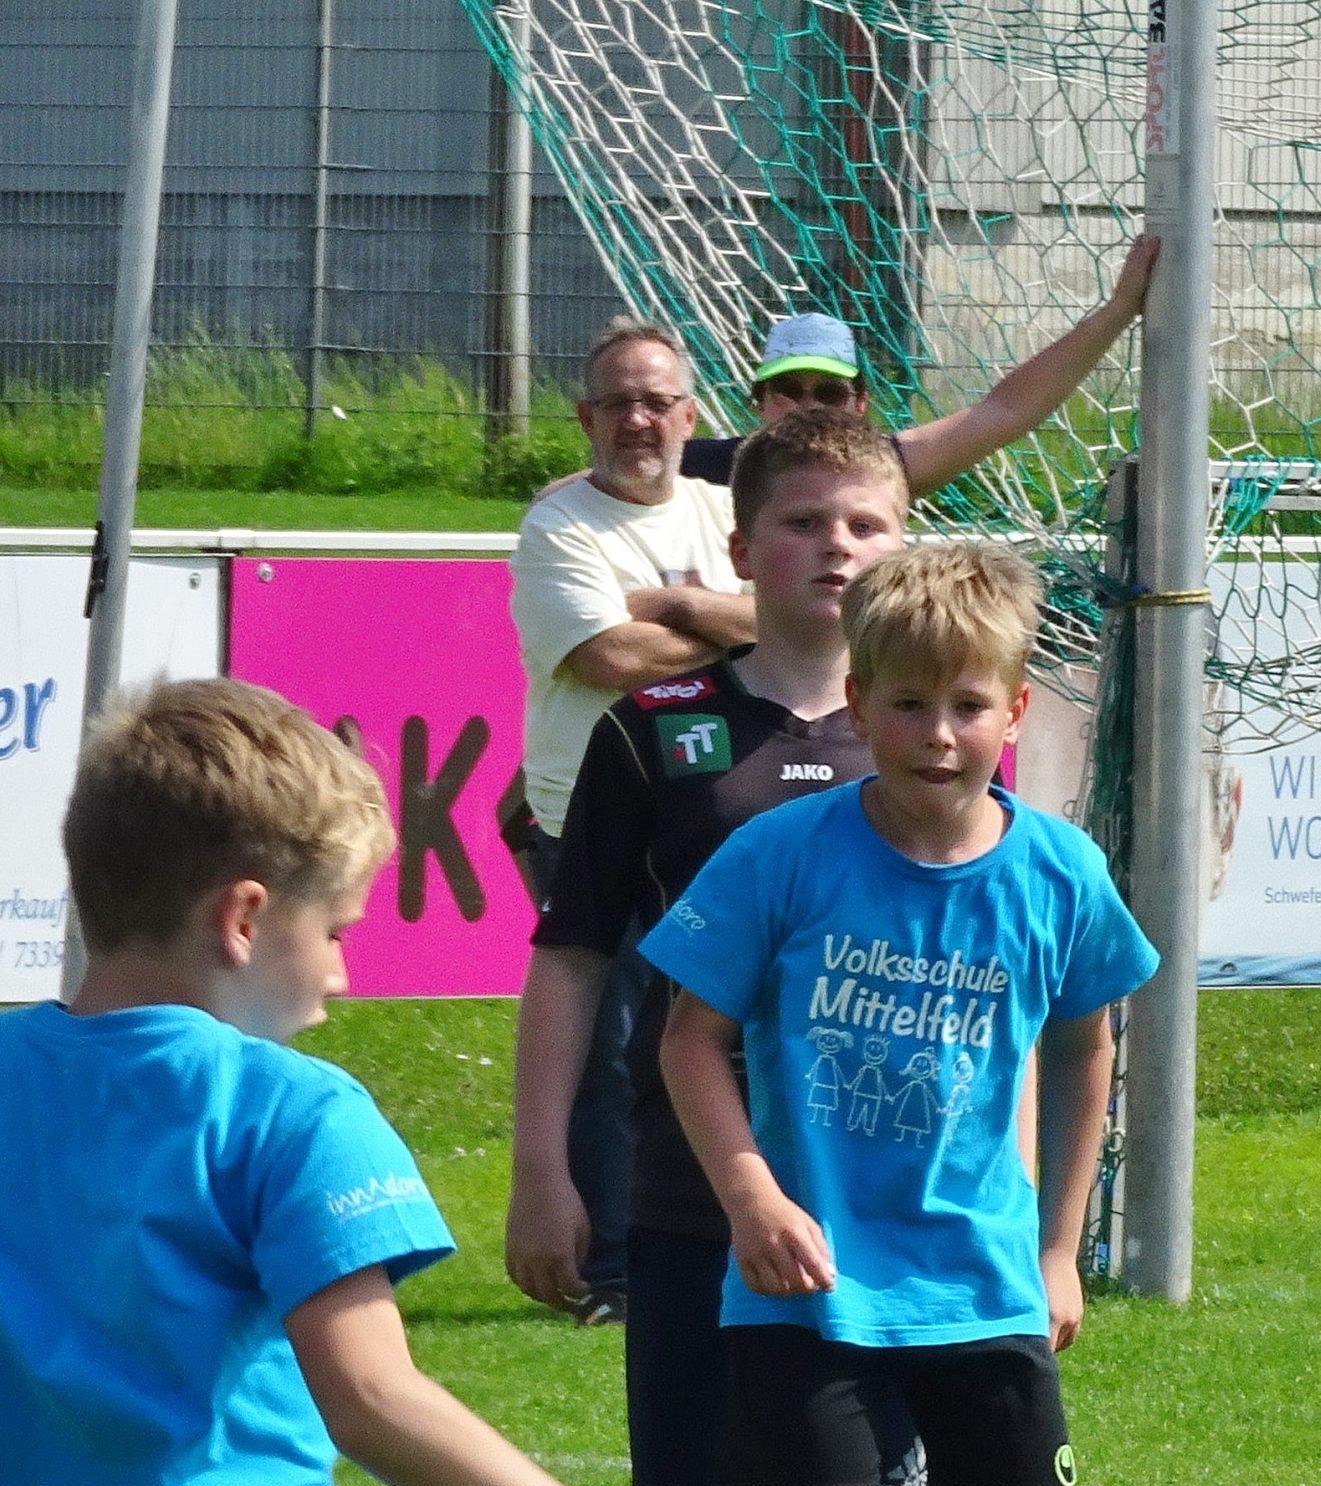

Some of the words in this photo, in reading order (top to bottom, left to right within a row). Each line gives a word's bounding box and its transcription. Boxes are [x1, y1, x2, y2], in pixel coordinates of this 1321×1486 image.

[780, 764, 834, 781] JAKO
[824, 934, 1009, 993] Volksschule
[809, 976, 998, 1048] Mittelfeld
